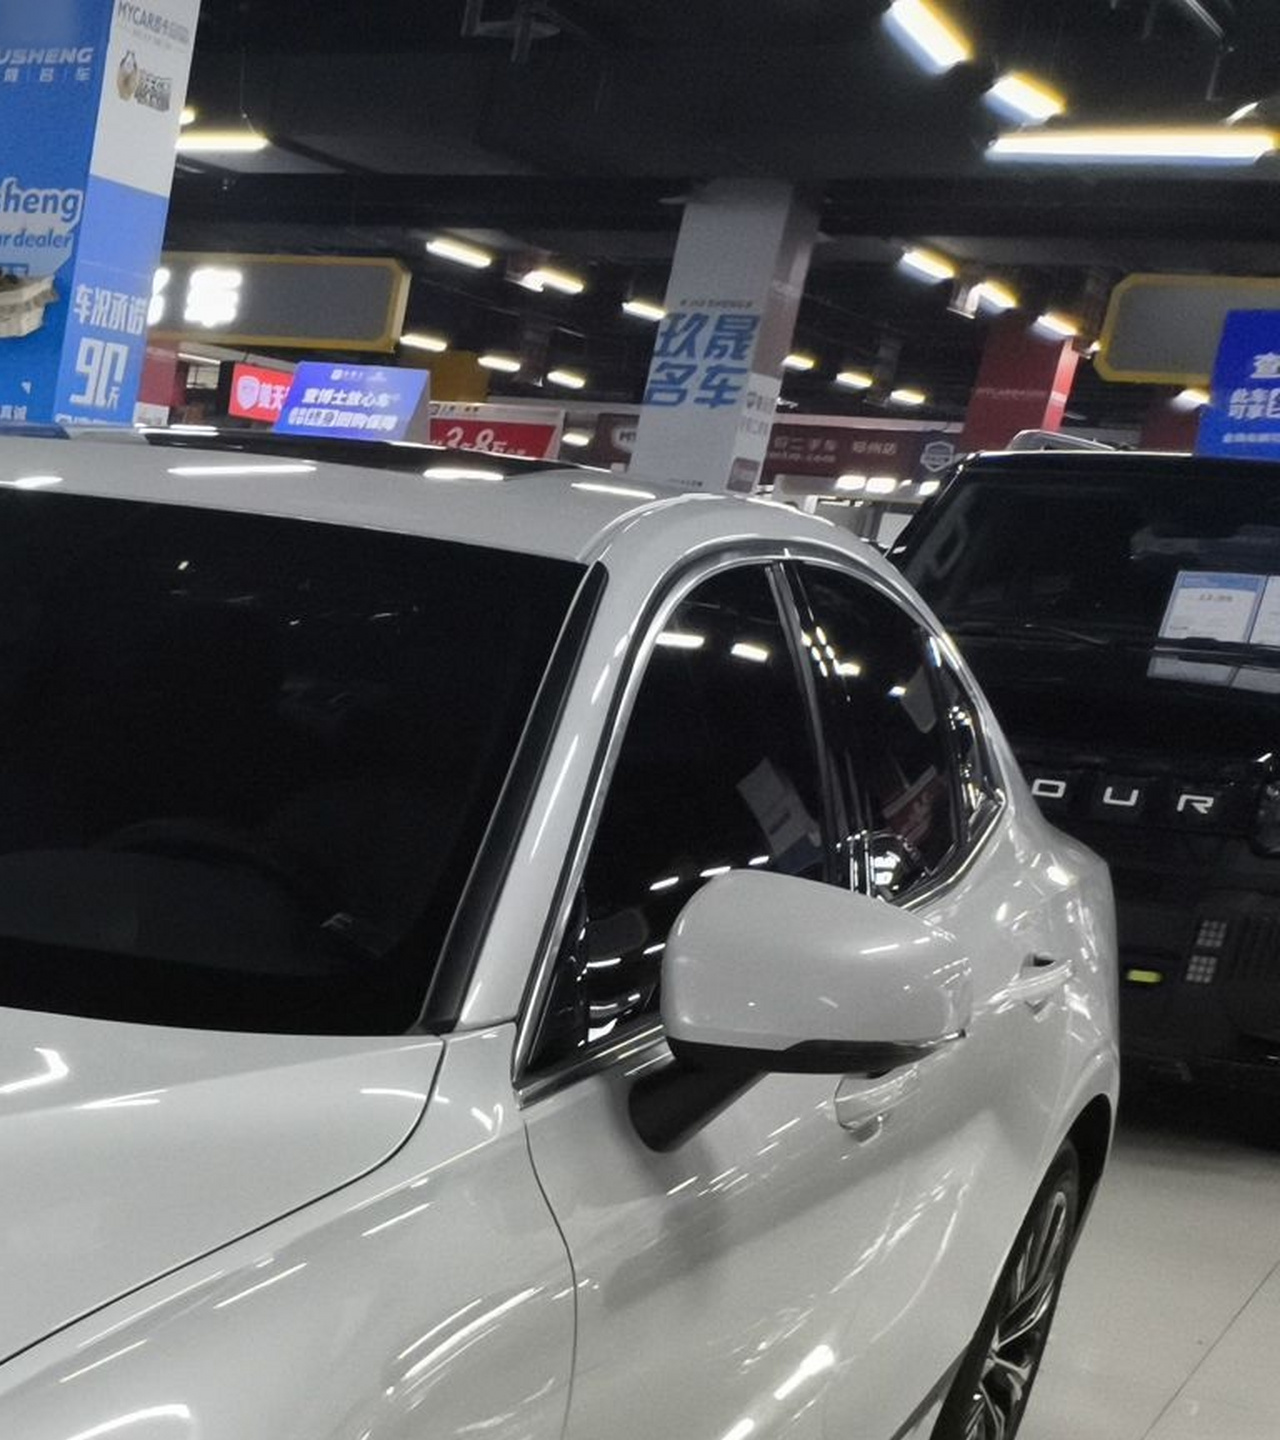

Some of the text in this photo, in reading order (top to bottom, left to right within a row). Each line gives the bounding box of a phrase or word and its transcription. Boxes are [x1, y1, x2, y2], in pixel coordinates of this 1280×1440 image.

[14, 228, 73, 249] dealer
[74, 283, 146, 335] 车况承诺
[653, 311, 762, 361] 玖晟
[643, 361, 748, 408] 名车
